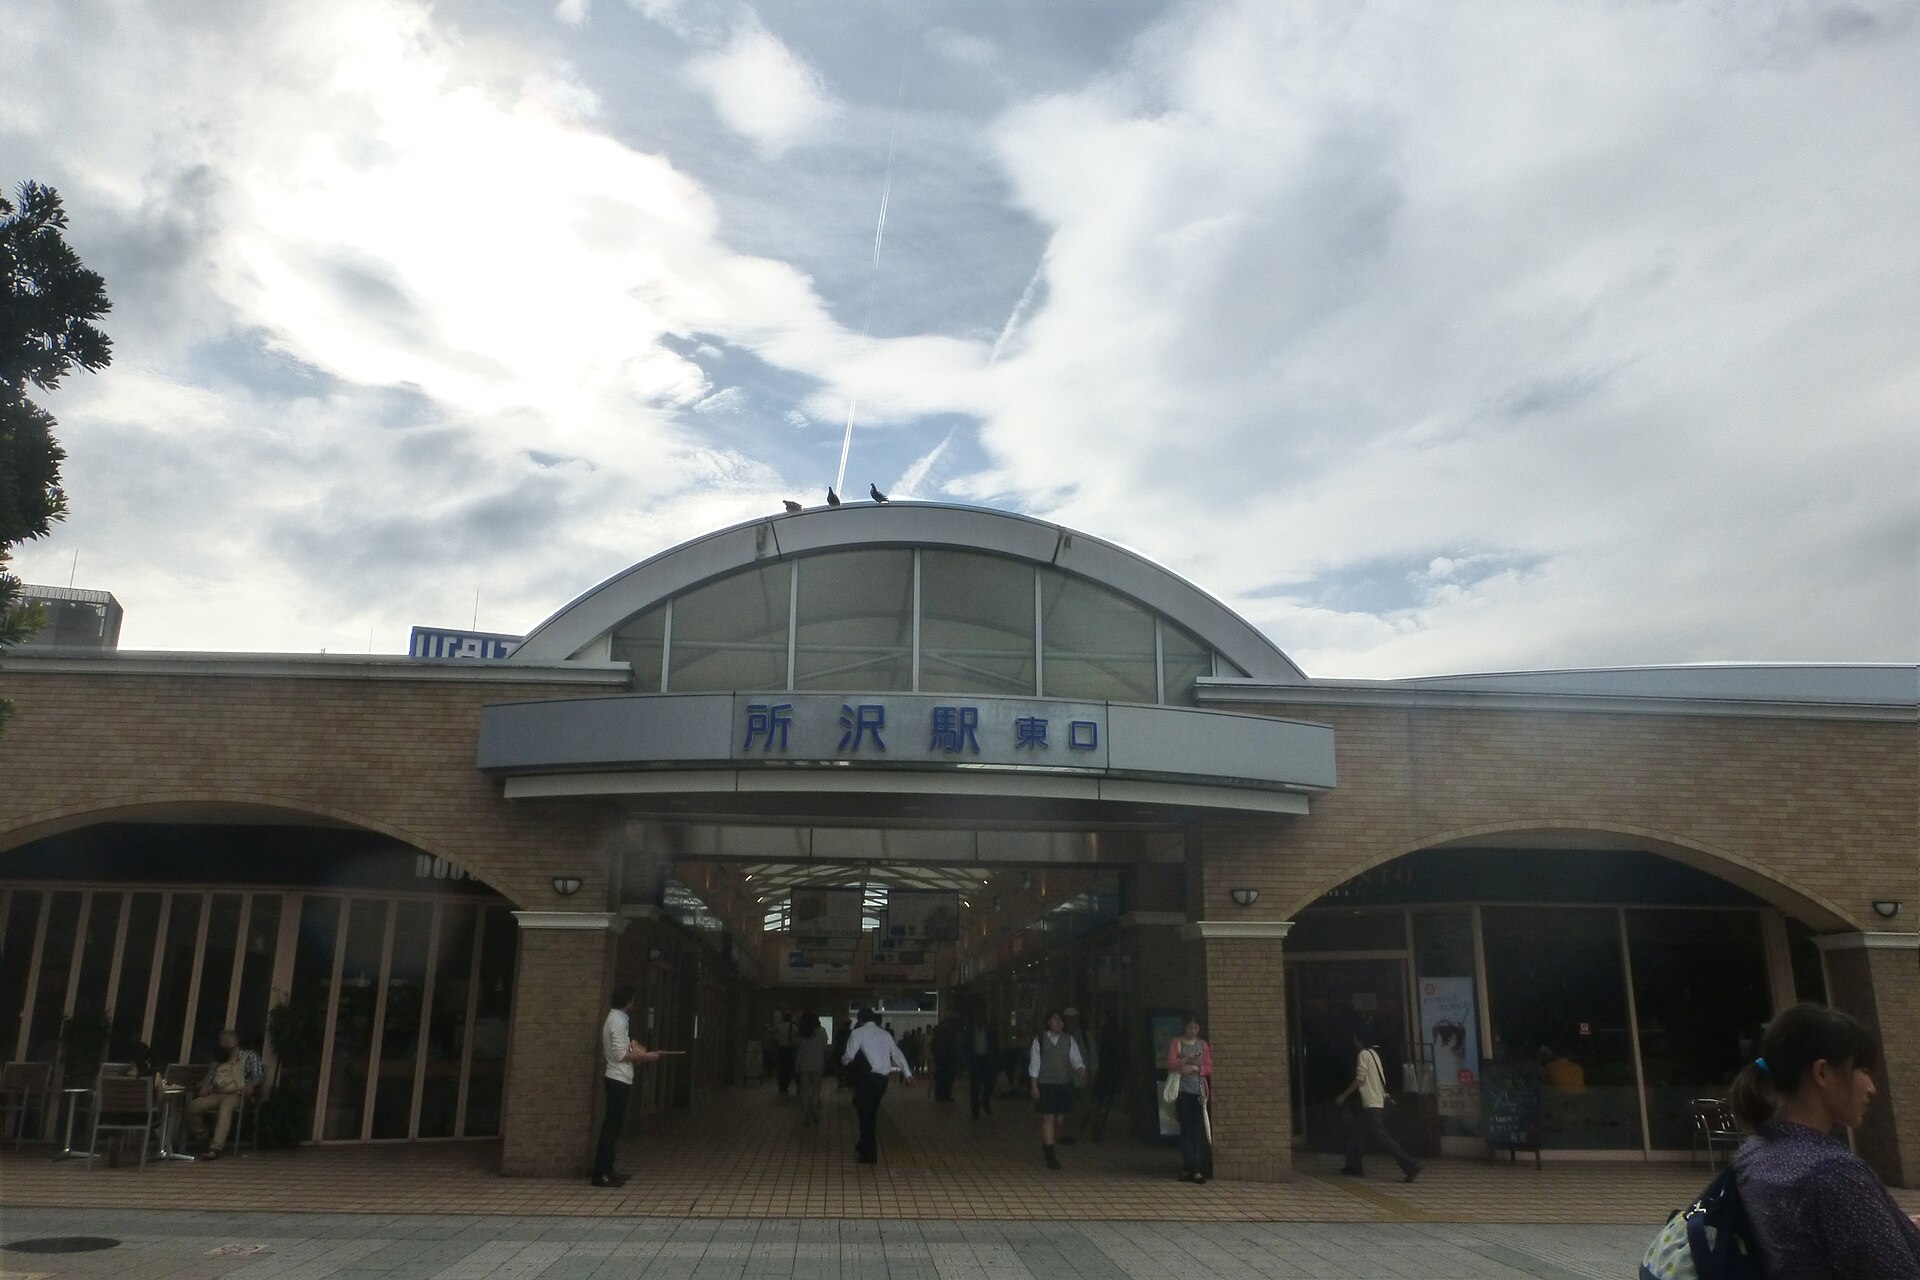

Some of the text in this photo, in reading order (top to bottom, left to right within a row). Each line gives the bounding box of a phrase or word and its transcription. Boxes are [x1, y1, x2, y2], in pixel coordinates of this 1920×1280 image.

[744, 703, 1098, 754] 所沢駅東口
